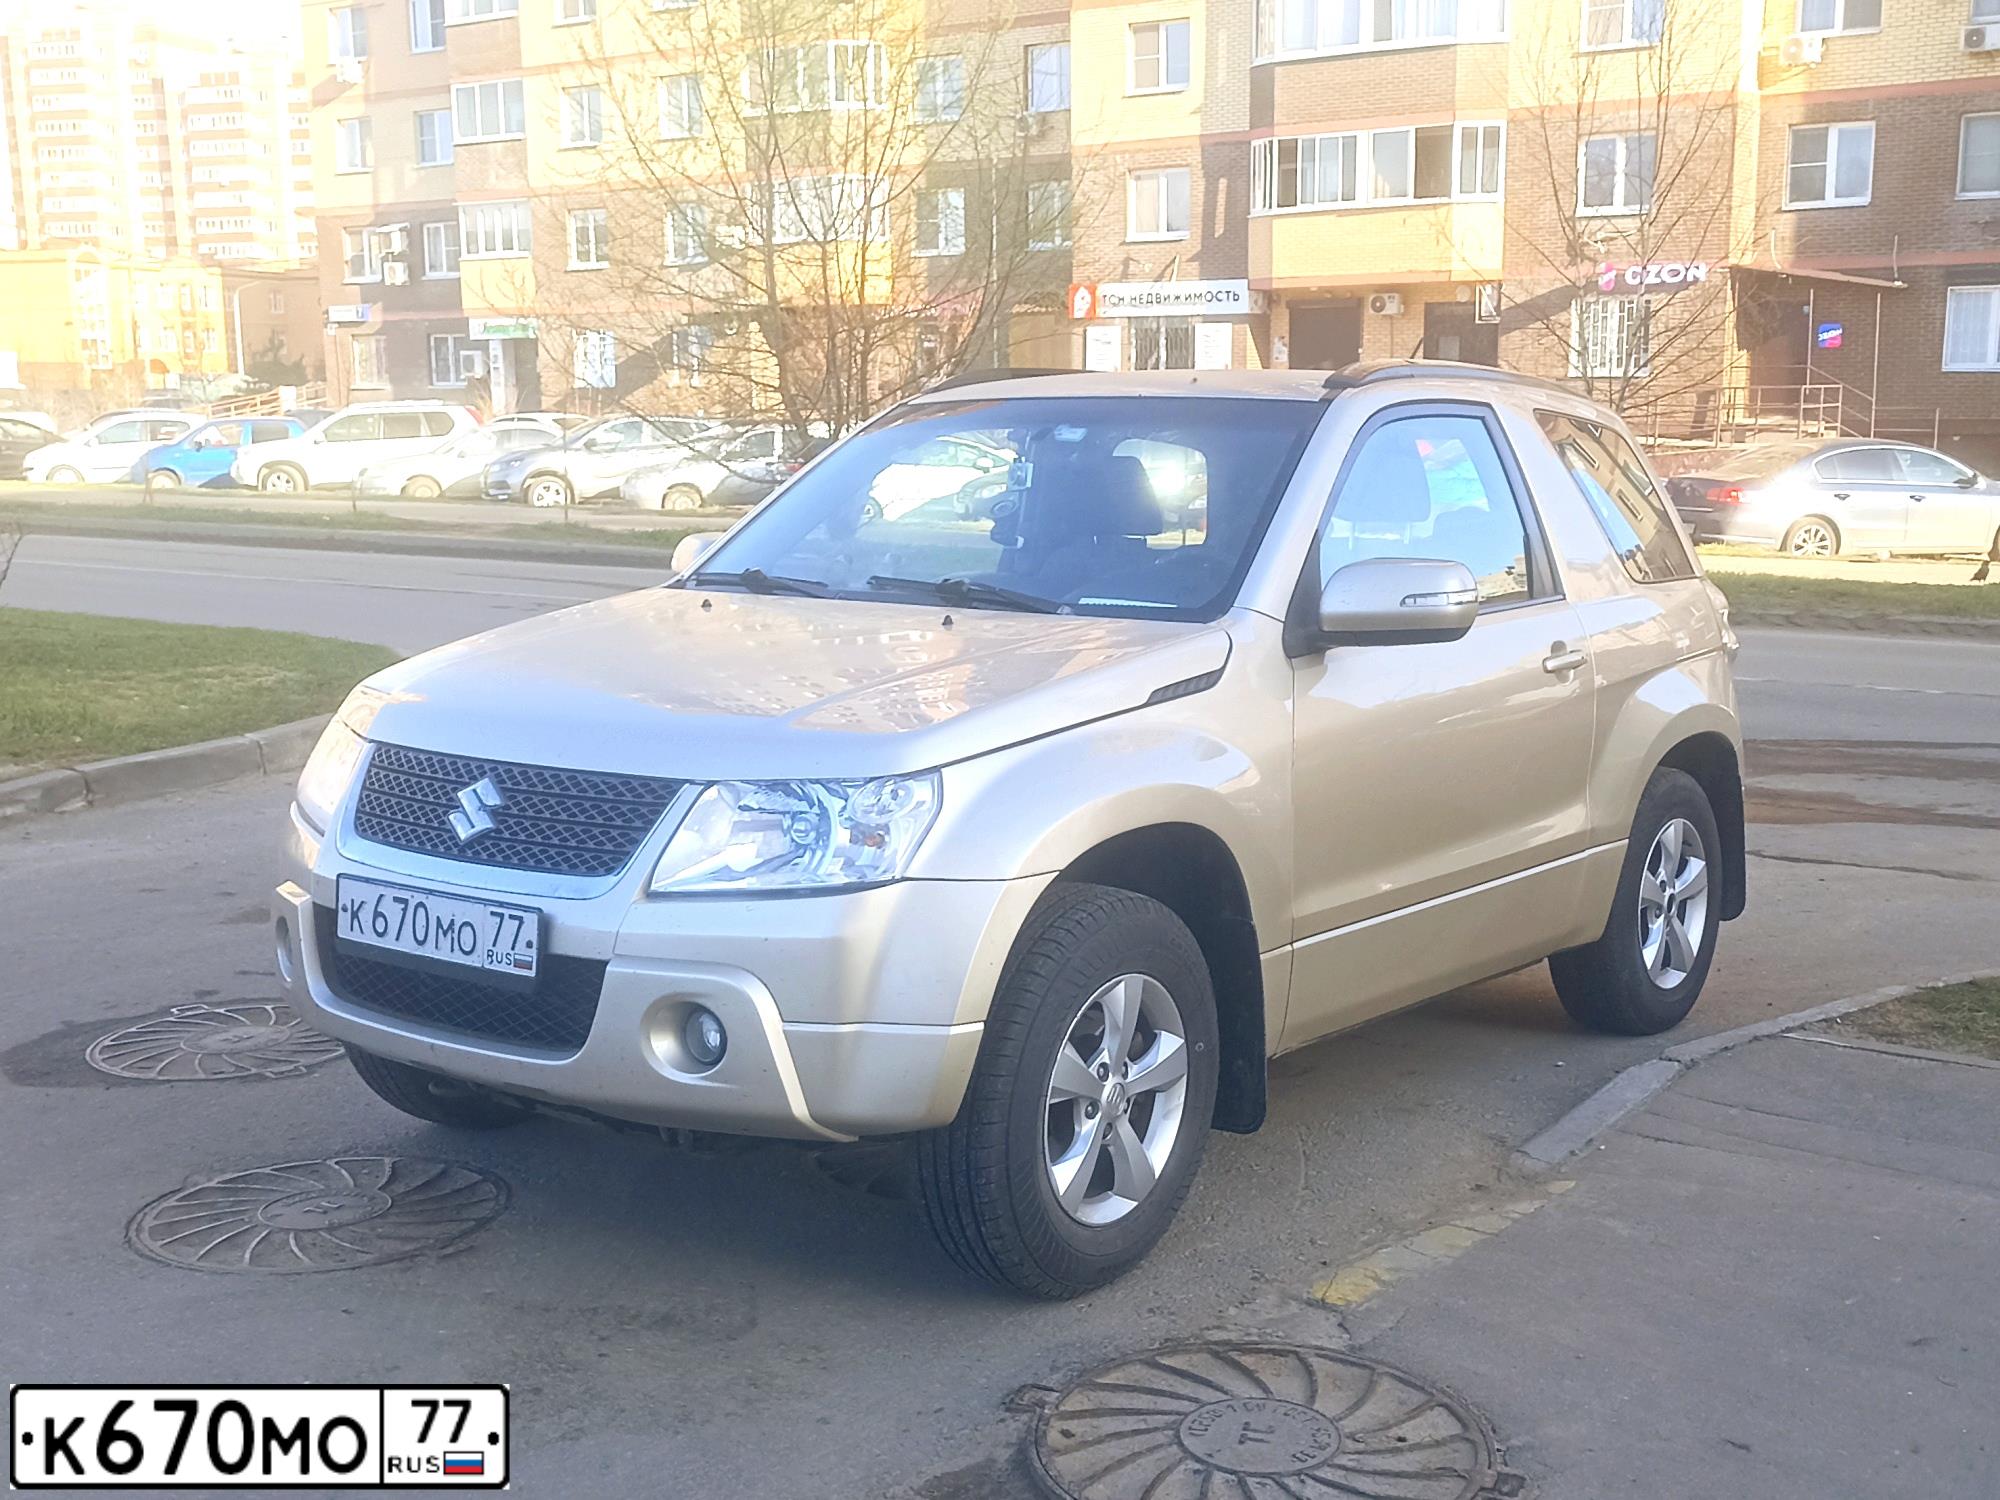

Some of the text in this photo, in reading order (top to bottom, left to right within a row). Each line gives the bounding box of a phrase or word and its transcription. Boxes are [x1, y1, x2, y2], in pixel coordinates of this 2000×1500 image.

[1130, 290, 1240, 305] НЕДВИЖИМОСТЬ
[349, 893, 525, 956] К670МО 77
[486, 949, 513, 966] RUS
